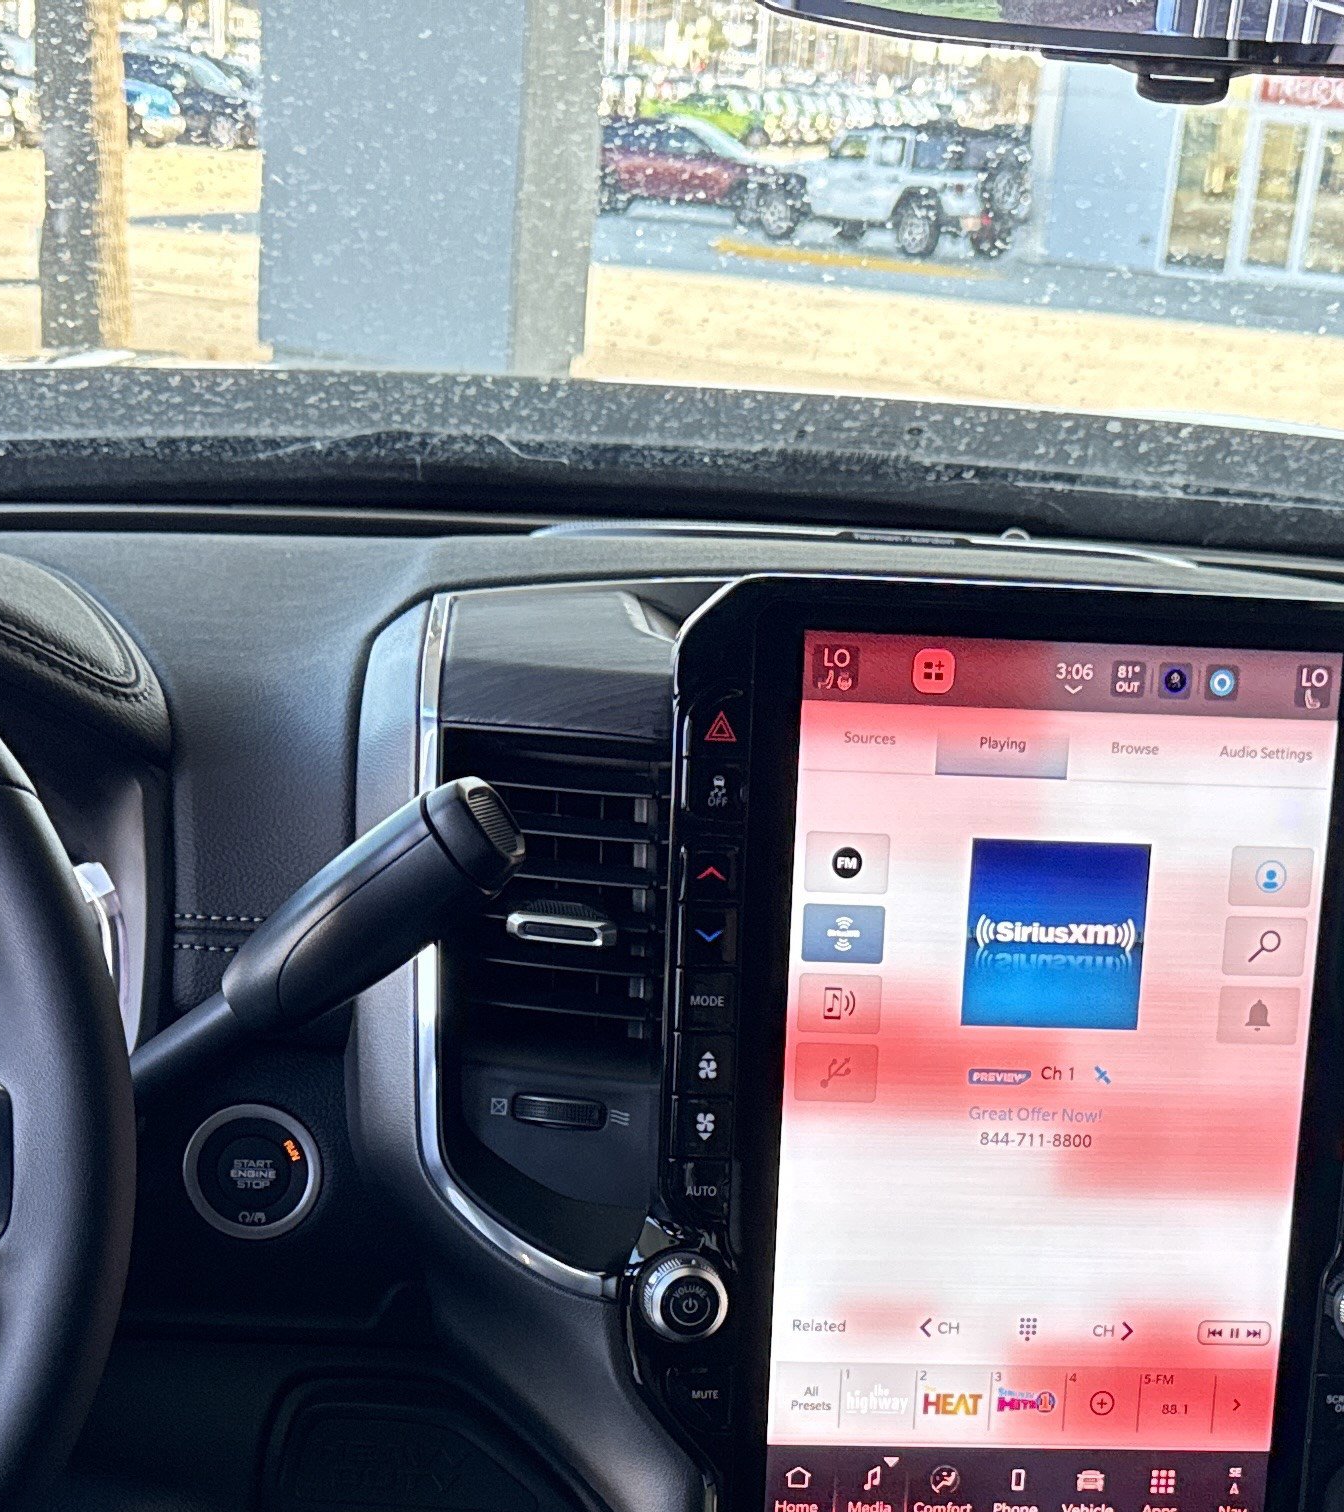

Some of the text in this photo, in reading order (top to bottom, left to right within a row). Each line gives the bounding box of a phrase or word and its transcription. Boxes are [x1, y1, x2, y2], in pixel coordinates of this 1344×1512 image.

[823, 648, 851, 667] LO
[1056, 662, 1094, 682] 3:06
[1117, 665, 1141, 679] 81°
[1301, 667, 1329, 688] LO
[1115, 681, 1141, 693] OUT
[843, 730, 897, 747] Sources
[979, 737, 1027, 754] Playing
[1111, 741, 1160, 756] Browse
[1219, 744, 1313, 763] Audio Settings
[707, 795, 729, 807] OFF
[837, 856, 858, 870] FM
[690, 995, 726, 1007] MODE
[1041, 1066, 1062, 1080] Ch
[1069, 1067, 1075, 1080] 1
[968, 1106, 1103, 1123] Great Offer Now!
[980, 1131, 1092, 1148] 844-711-8800
[233, 1159, 274, 1168] START
[229, 1168, 277, 1179] ENGINE
[236, 1180, 271, 1189] STOP
[685, 1186, 717, 1197] AUTO
[672, 1284, 709, 1300] VOLUME
[792, 1318, 847, 1334] Related
[937, 1322, 960, 1336] CH
[1092, 1324, 1115, 1338] CH
[919, 1370, 927, 1381] 2
[994, 1371, 1002, 1382] 3
[1069, 1372, 1077, 1383] 4
[1144, 1374, 1174, 1385] 5-FM
[691, 1389, 719, 1399] MUTE
[803, 1386, 819, 1397] All
[790, 1400, 832, 1411] Presets
[846, 1391, 909, 1415] highway
[922, 1393, 983, 1416] HEAT
[1161, 1403, 1189, 1415] 88.1
